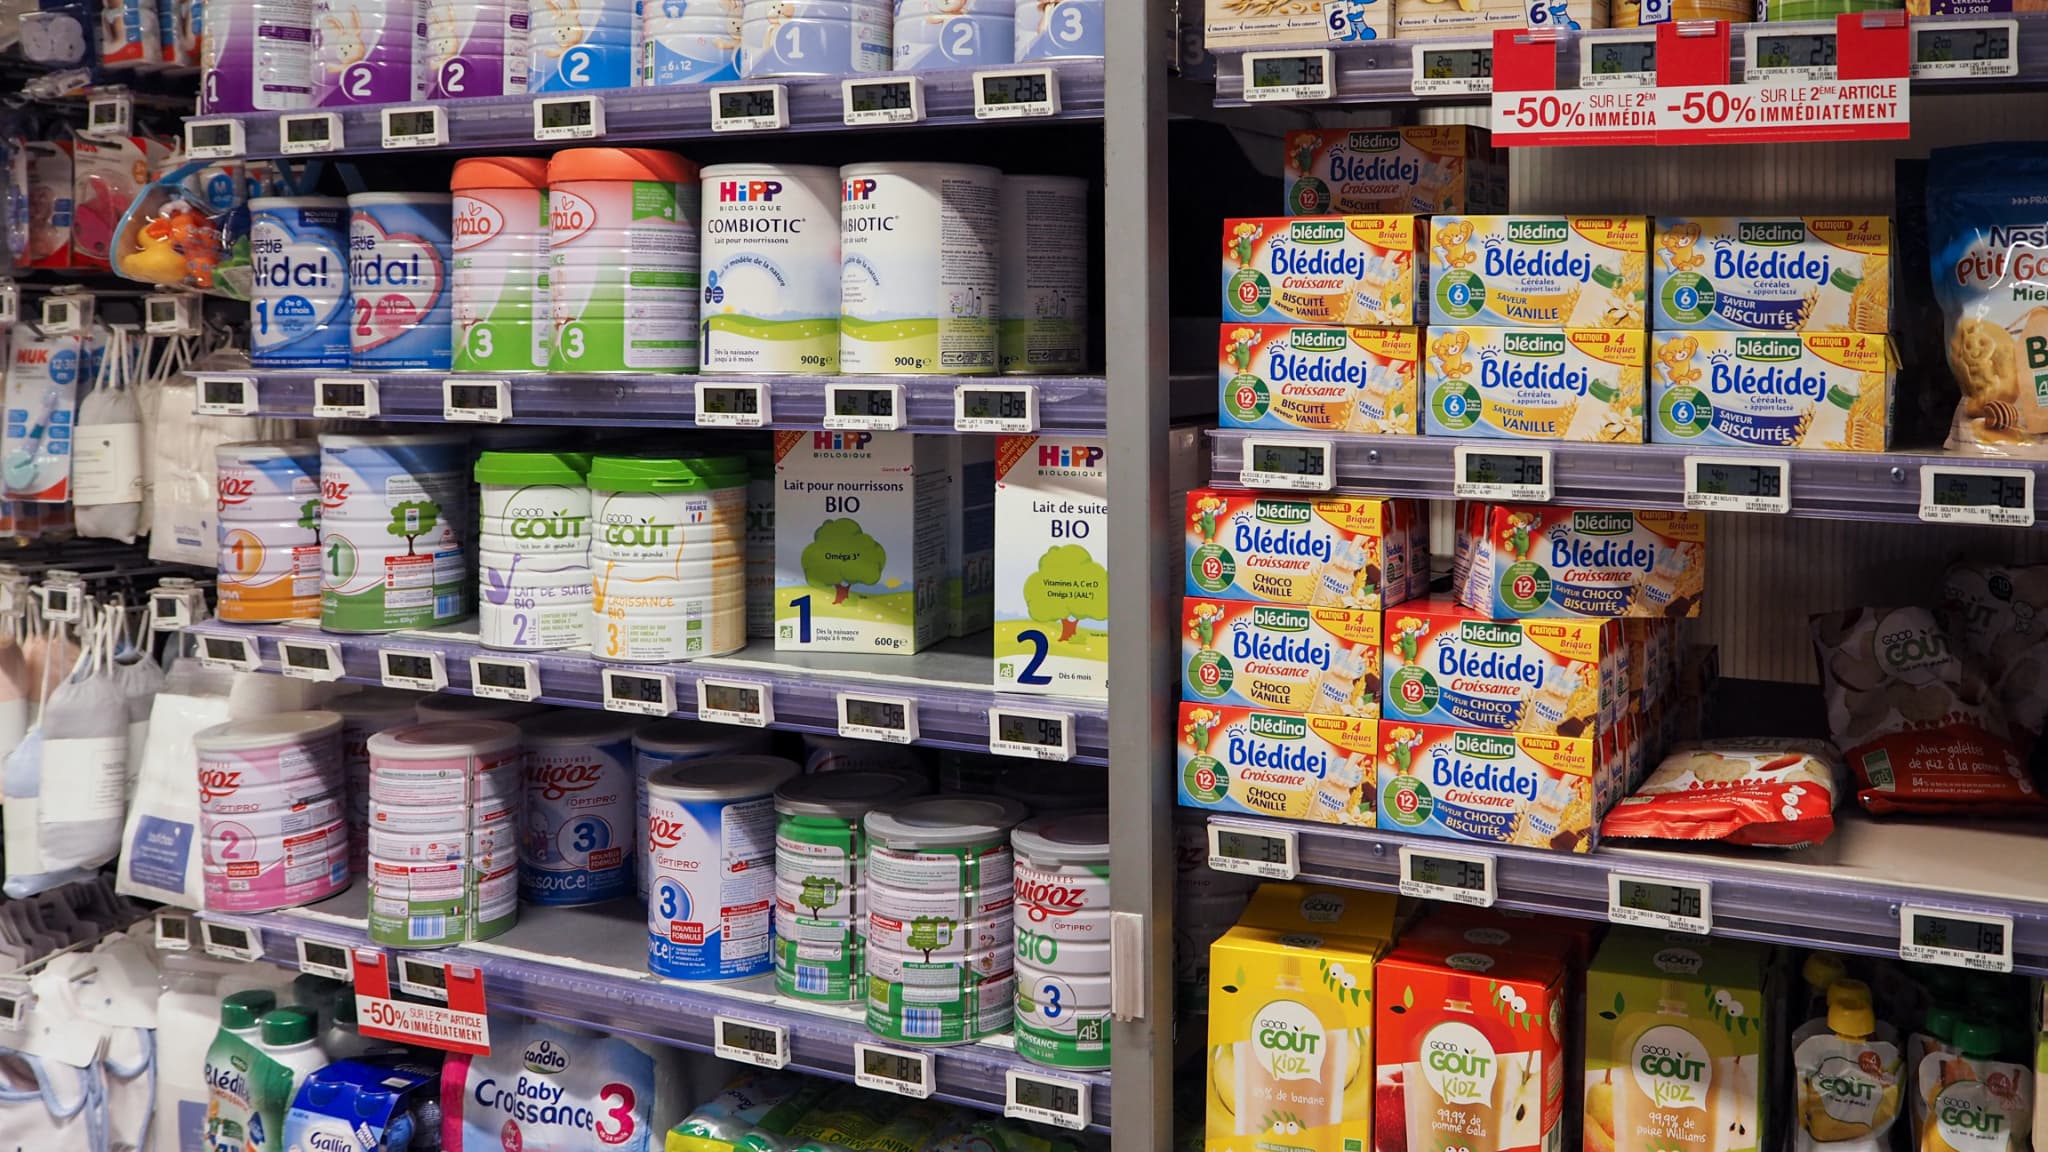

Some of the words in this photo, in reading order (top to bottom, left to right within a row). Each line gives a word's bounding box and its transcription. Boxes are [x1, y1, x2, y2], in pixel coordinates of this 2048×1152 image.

[1530, 6, 1547, 24] 6
[1953, 6, 1968, 14] DU
[1970, 5, 1989, 14] SOIR
[1059, 7, 1083, 42] 3
[1329, 10, 1346, 31] 6
[786, 27, 804, 58] 1
[952, 23, 973, 56] 2
[570, 52, 590, 82] 2
[352, 68, 372, 96] 2
[448, 63, 465, 92] 2
[207, 75, 219, 102] 1
[1761, 88, 1787, 103] SUR
[1791, 87, 1806, 102] LE
[1839, 84, 1897, 99] ARTICLE
[1589, 95, 1615, 109] SUR
[1617, 94, 1633, 108] LE
[1589, 109, 1656, 127] IMMÉDIA
[1760, 102, 1897, 122] IMMÉDIATEMENT
[1330, 156, 1419, 185] Blédidej
[720, 181, 783, 202] HiPP
[1270, 247, 1365, 281] Blédidej
[1485, 247, 1590, 283] Blédidej
[1282, 276, 1344, 289] Croissance
[1520, 277, 1555, 286] Céréales
[1753, 280, 1790, 288] Céréales
[1242, 287, 1255, 299] 12
[1282, 292, 1325, 307] BISCUITÉ
[1496, 292, 1527, 305] SAVEUR
[1721, 295, 1756, 309] SAVEUR
[256, 298, 268, 335] 1
[356, 298, 373, 336] 2
[1505, 304, 1559, 320] VANILLE
[1721, 305, 1794, 325] BISCUITÉE
[475, 328, 494, 358] 3
[566, 328, 585, 359] 3
[1291, 330, 1346, 348] blédina
[1736, 337, 1800, 357] blédina
[1855, 337, 1866, 350] 4
[16, 349, 49, 363] NUK
[1603, 345, 1636, 355] Briques
[1843, 349, 1879, 359] Briques
[1270, 354, 1367, 388] Blédidej
[1281, 382, 1346, 397] Croissance
[1517, 390, 1551, 398] Céréales
[1281, 399, 1326, 415] BISCUITÉ
[1750, 396, 1787, 404] Céréales
[1492, 404, 1524, 417] SAVEUR
[1719, 410, 1753, 424] SAVEUR
[1502, 416, 1556, 432] VANILLE
[1719, 421, 1791, 441] BISCUITÉE
[1038, 445, 1104, 468] HiPP
[784, 480, 804, 490] Lait
[807, 482, 835, 493] pour
[837, 480, 904, 492] nourrissons
[685, 504, 708, 512] FRANCE
[825, 496, 861, 513] BIO
[1033, 500, 1056, 513] Lait
[1059, 501, 1075, 513] de
[1078, 502, 1109, 515] suite
[1256, 502, 1311, 521] blédina
[1051, 519, 1090, 539] BIO
[231, 538, 244, 571] 1
[327, 543, 340, 577] 1
[1551, 539, 1654, 572] Blédidej
[1043, 579, 1073, 587] Vitamines
[1255, 573, 1293, 588] CHOCO
[1563, 568, 1633, 583] Croissance
[540, 586, 556, 598] DE
[1252, 582, 1293, 597] VANILLE
[1517, 580, 1531, 594] 12
[514, 598, 536, 609] BIO
[1563, 598, 1617, 612] BISCUITÉE
[789, 595, 811, 644] 1
[1254, 606, 1309, 628] blédina
[512, 613, 528, 645] 2
[833, 629, 860, 637] naissance
[1461, 621, 1521, 643] blédina
[1571, 628, 1582, 640] 4
[1233, 631, 1330, 671] Blédidej
[1058, 671, 1070, 680] Dès
[1072, 672, 1076, 680] 6
[1077, 673, 1092, 681] mois
[1438, 646, 1544, 689] Blédidej
[1252, 680, 1291, 695] CHOCO
[1456, 733, 1515, 756] blédina
[1564, 741, 1575, 755] 4
[1908, 758, 1922, 769] de
[1958, 759, 1968, 771] la
[1198, 773, 1212, 786] 12
[1240, 767, 1305, 786] Croissance
[1432, 757, 1538, 801] Blédidej
[1246, 794, 1287, 812] VANILLE
[1248, 786, 1287, 802] CHOCO
[1399, 795, 1413, 809] 12
[1445, 788, 1515, 808] Croissance
[1445, 817, 1500, 837] BISCUITÉE
[220, 830, 241, 859] 2
[573, 822, 597, 853] 3
[659, 885, 677, 919] 3
[671, 923, 701, 933] NOUVELLE
[1054, 922, 1093, 932] OPTIPRO
[671, 932, 702, 941] FORMULE
[1043, 984, 1062, 1018] 3
[410, 1008, 425, 1019] SUR
[425, 1010, 434, 1020] LE
[450, 1014, 482, 1028] ARTICLE
[1260, 1019, 1288, 1030] GOOD
[410, 1020, 483, 1043] IMMÉDIATEMENT
[1430, 1040, 1458, 1051] GOOD
[1641, 1044, 1671, 1057] GOOD
[524, 1048, 566, 1068] candia
[516, 1076, 565, 1105] Baby
[474, 1078, 594, 1131] Croissance
[596, 1082, 636, 1145] 3
[1470, 1115, 1481, 1125] de
[1431, 1121, 1463, 1133] pomme
[1466, 1126, 1488, 1138] Gala
